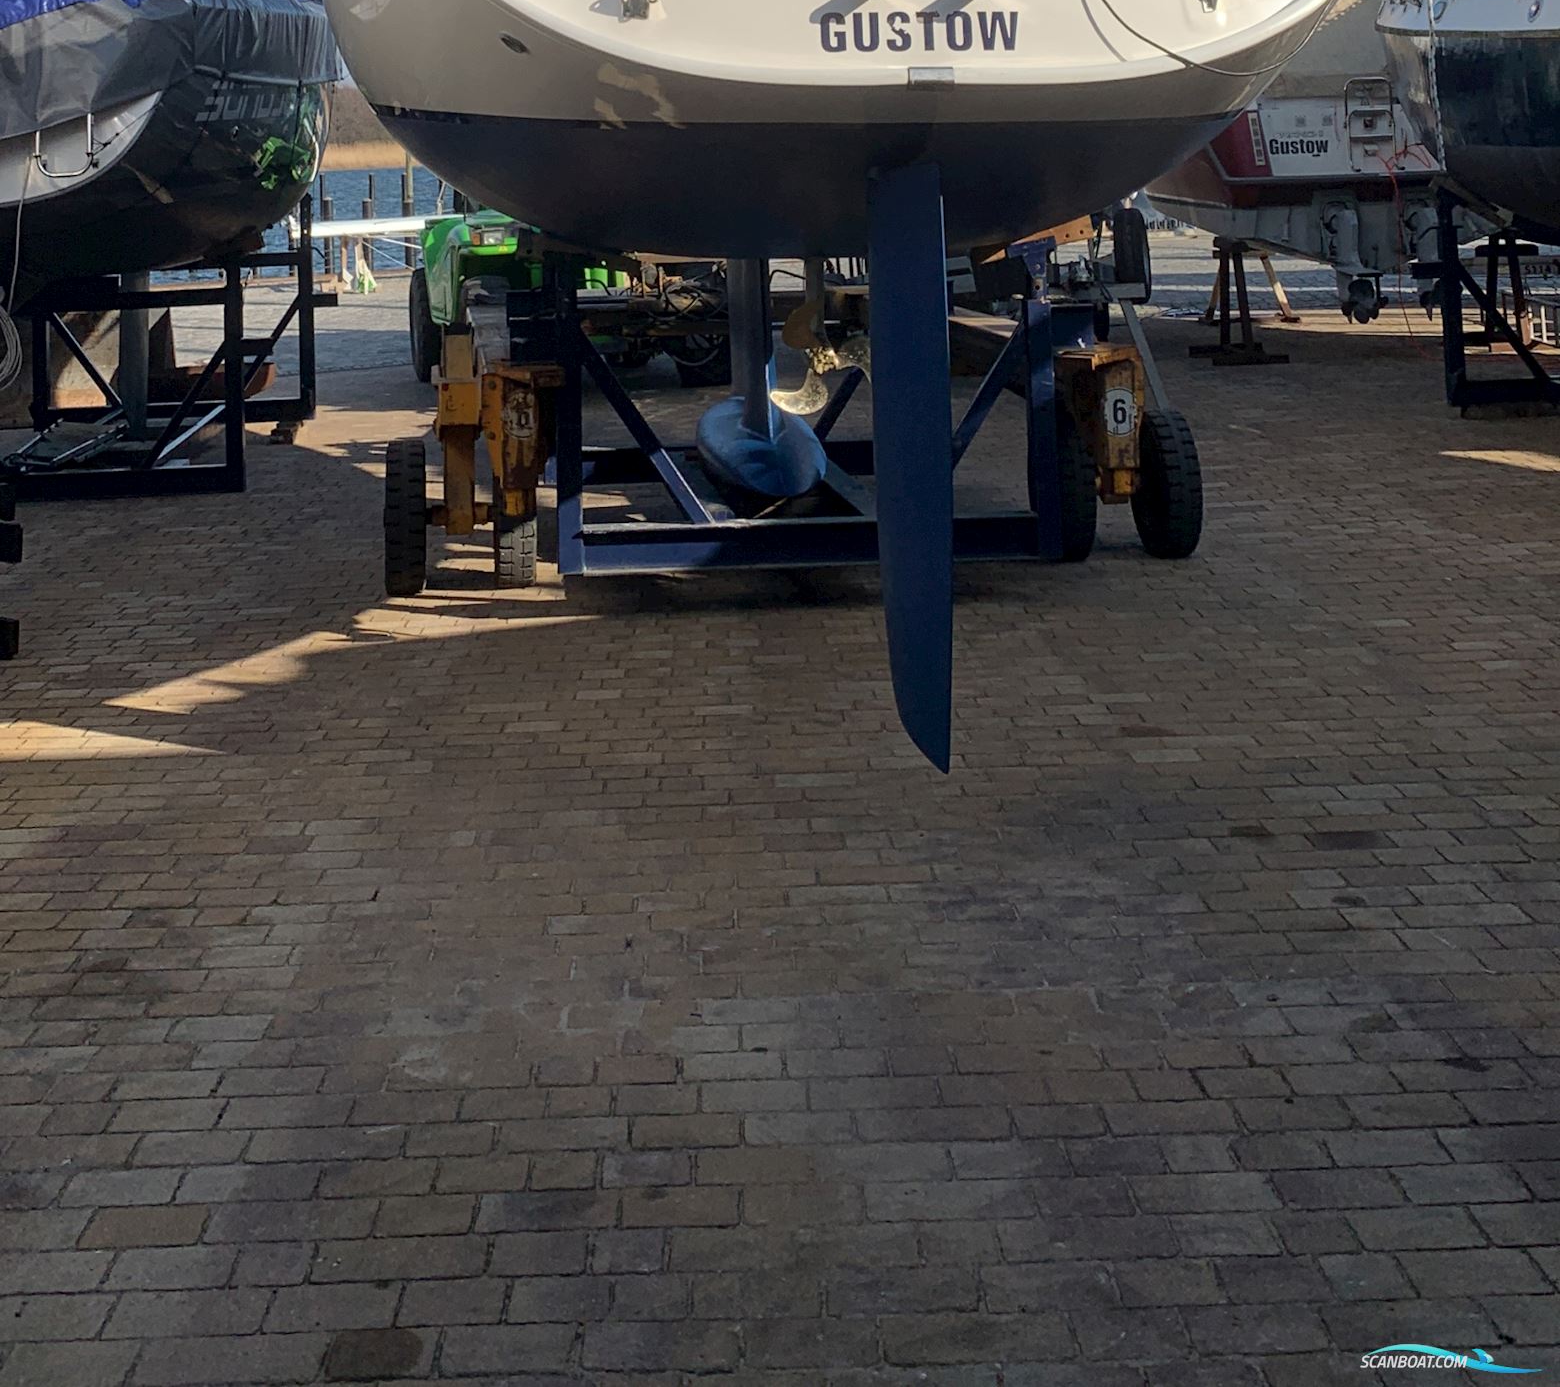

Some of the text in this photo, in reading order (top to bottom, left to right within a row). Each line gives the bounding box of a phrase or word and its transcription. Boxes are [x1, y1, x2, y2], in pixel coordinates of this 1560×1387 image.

[820, 11, 1019, 52] GUSTOW
[1269, 138, 1329, 155] Gustow
[1112, 398, 1127, 424] 6
